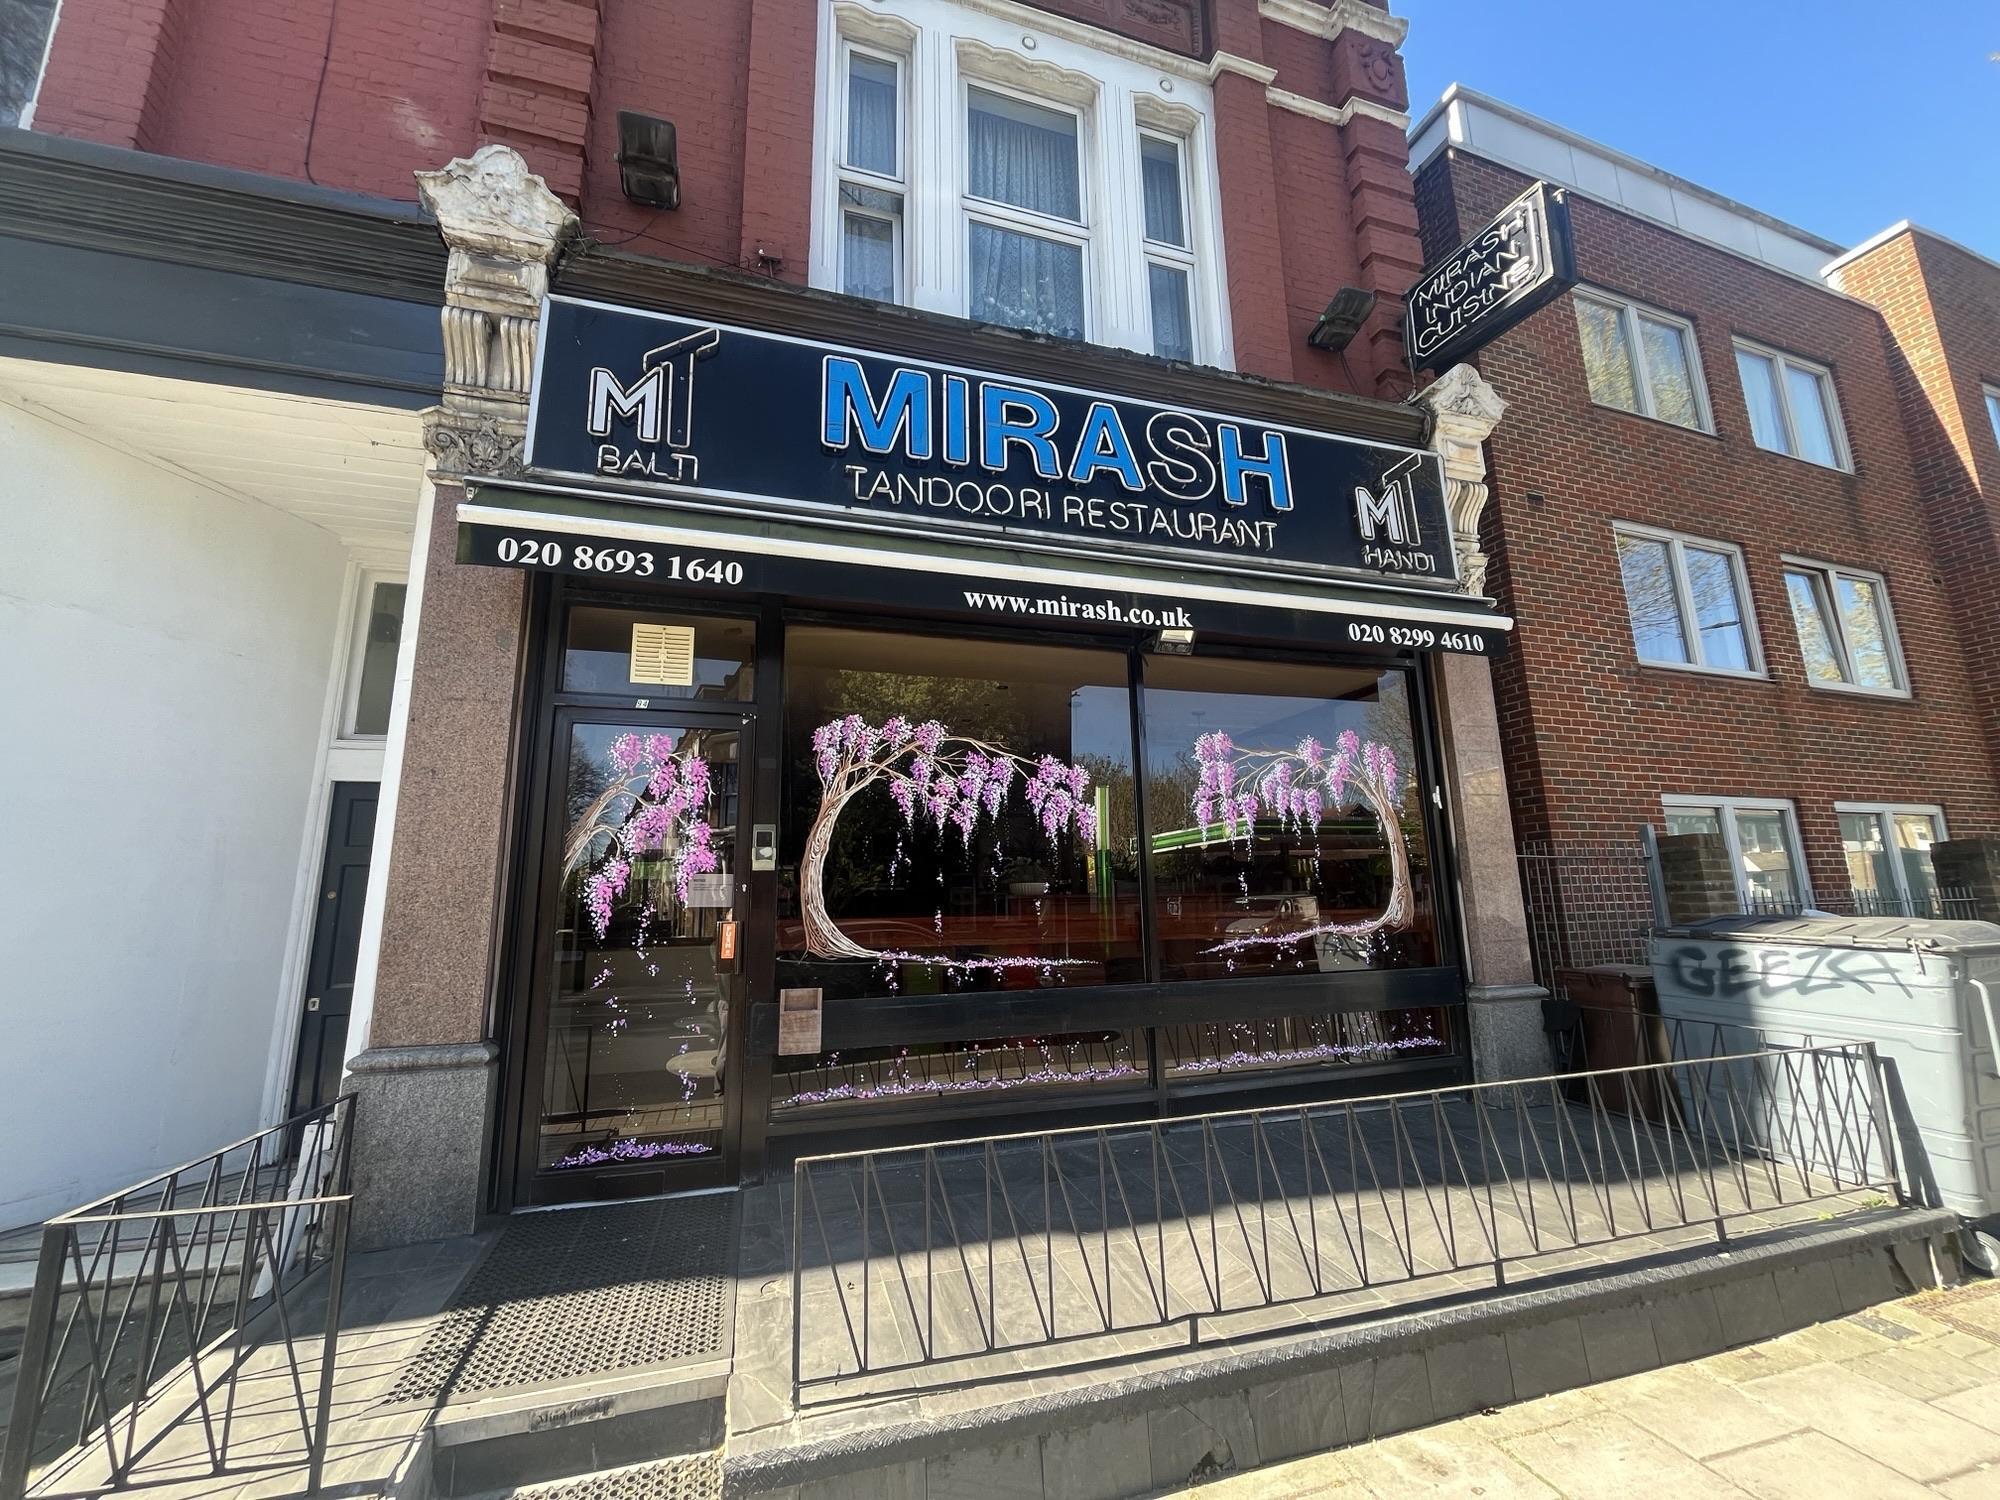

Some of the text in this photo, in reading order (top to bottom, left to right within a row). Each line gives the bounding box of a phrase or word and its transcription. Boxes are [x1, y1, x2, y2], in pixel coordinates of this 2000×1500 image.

[1419, 209, 1526, 306] MIRASH
[1427, 239, 1521, 324] INDIAN
[1419, 255, 1531, 348] CUISINE
[820, 354, 1294, 512] MIRASH
[597, 444, 699, 481] BALTI
[845, 464, 1277, 550] TANDOORI RESTAURANT
[496, 537, 744, 586] 020 8693 1640
[1361, 545, 1436, 573] HANDI
[963, 591, 1193, 629] www.mirash.co.uk
[1347, 621, 1485, 652] 020 8299 4610
[537, 1410, 567, 1425] Mind
